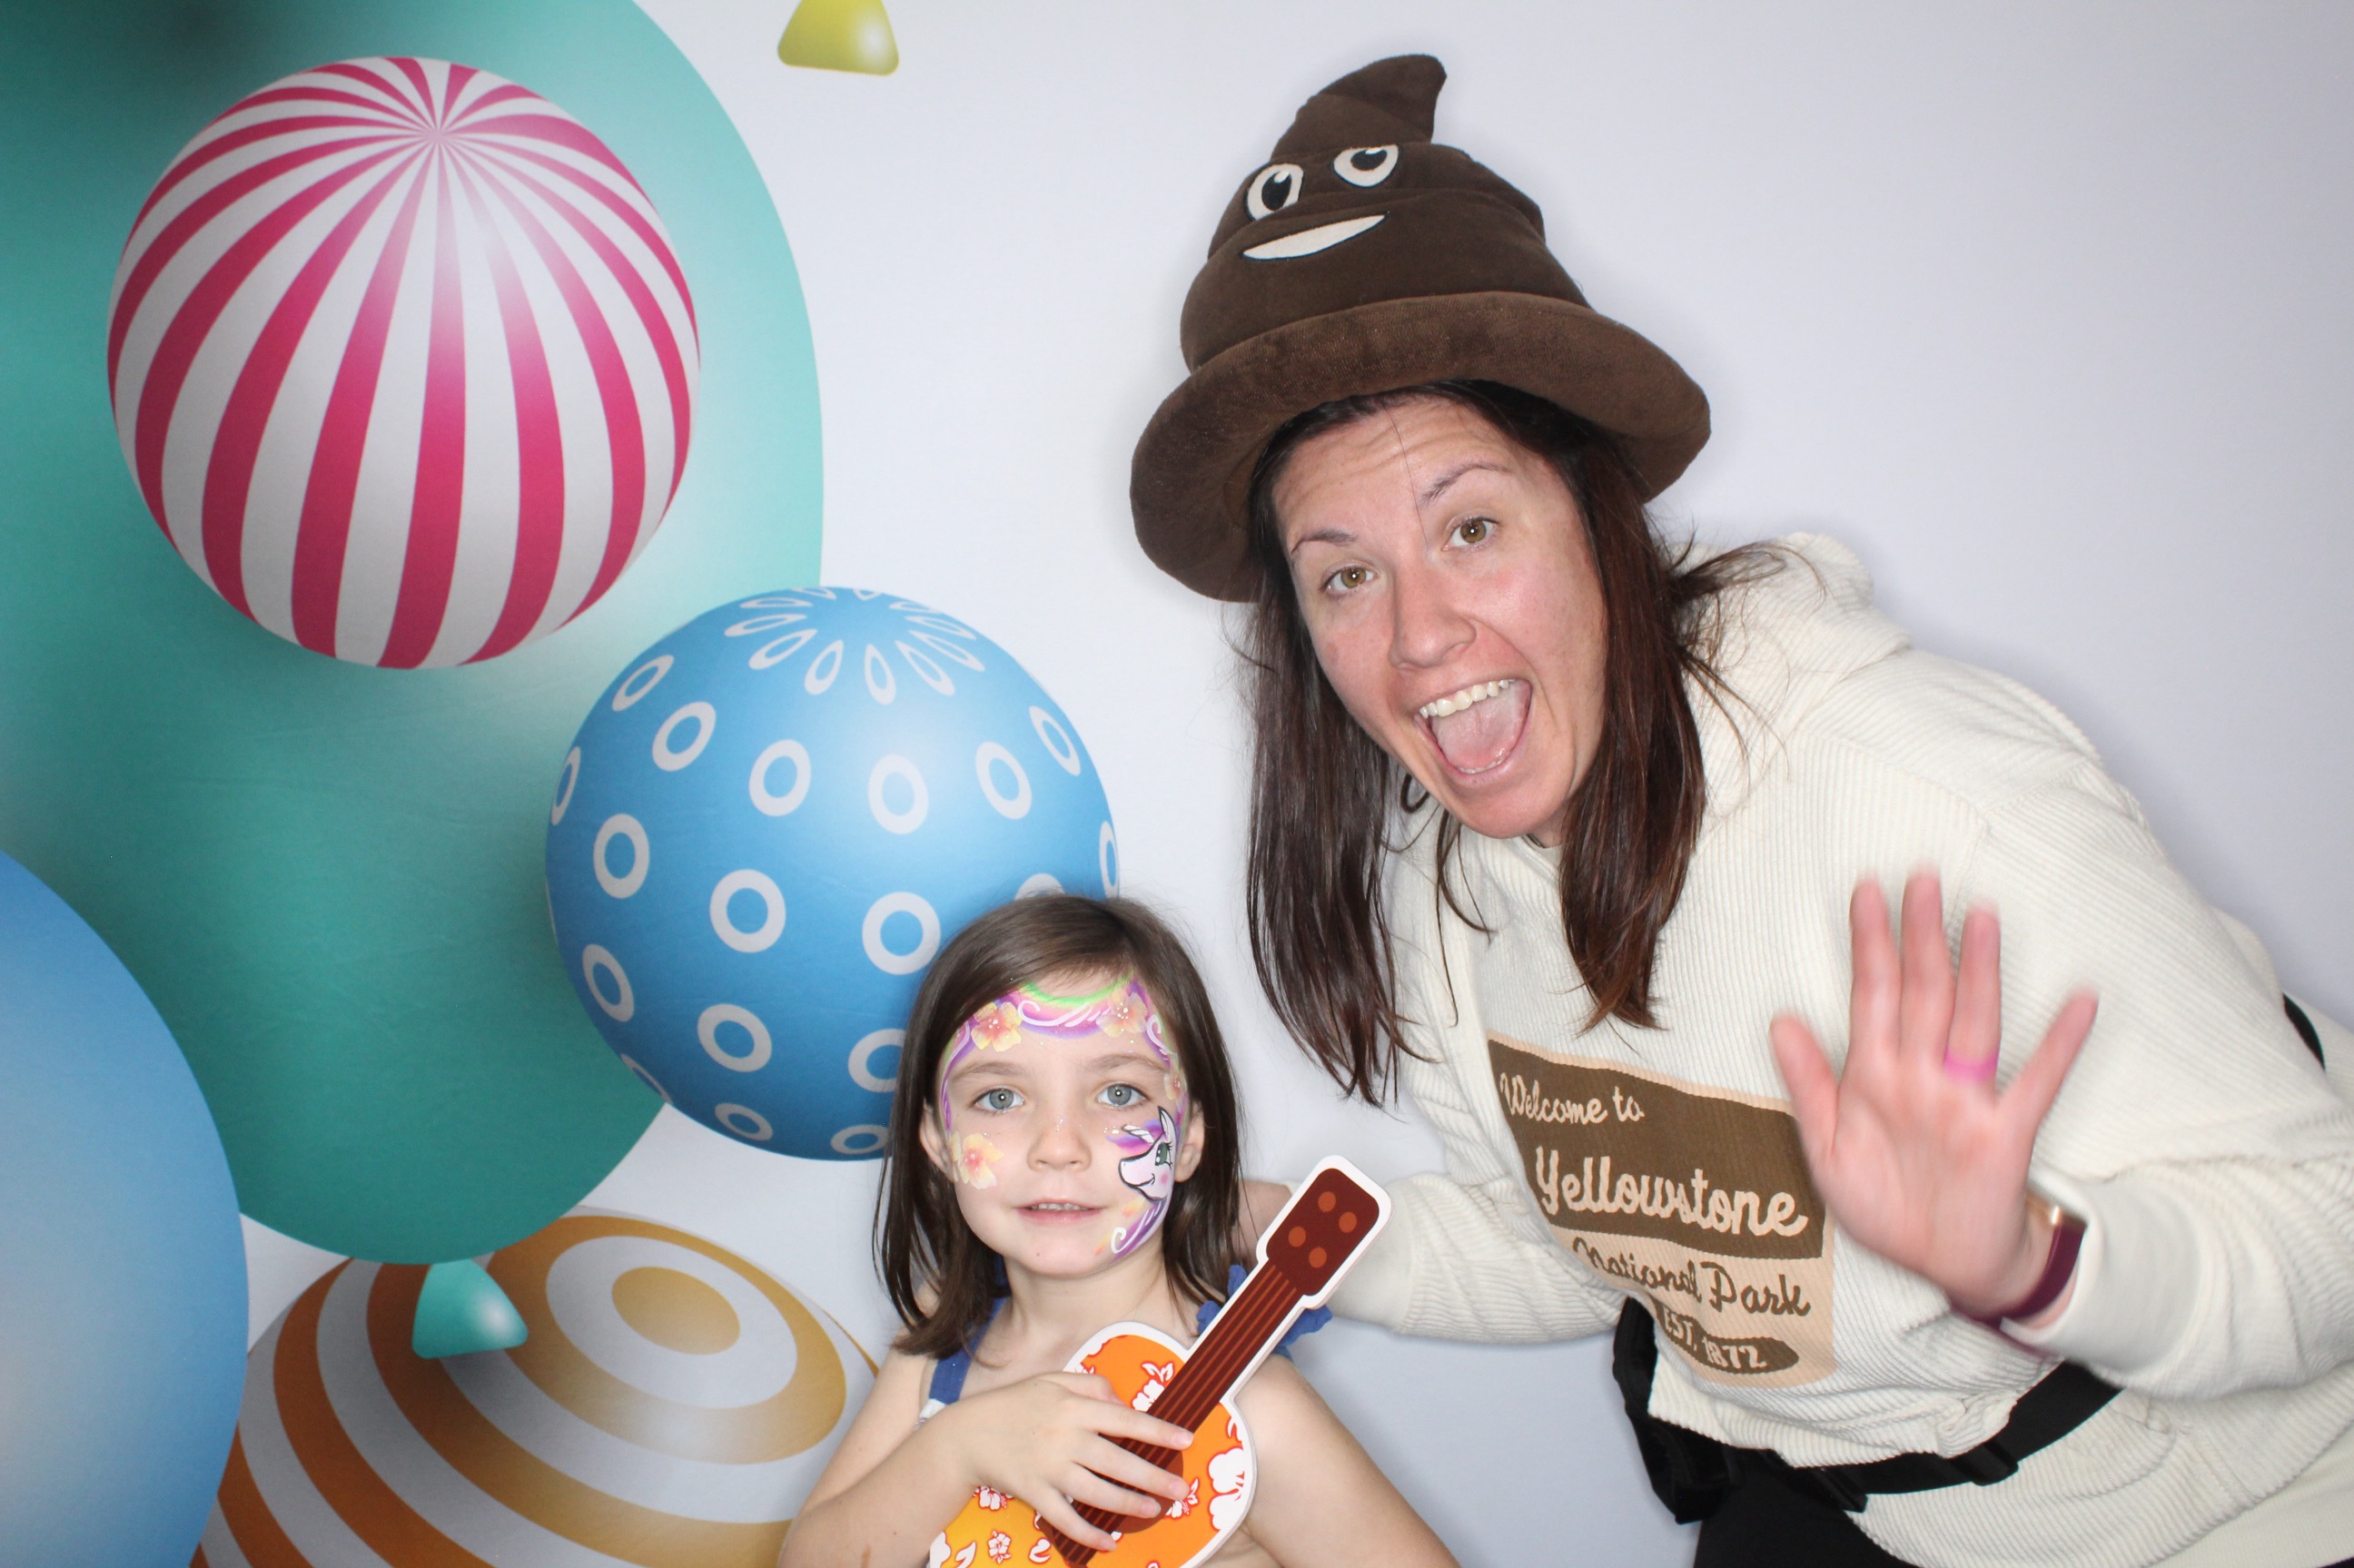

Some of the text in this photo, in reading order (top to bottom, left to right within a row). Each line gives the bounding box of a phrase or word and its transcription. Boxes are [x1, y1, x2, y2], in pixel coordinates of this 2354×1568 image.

[1499, 1072, 1646, 1125] Welcome to
[1535, 1146, 1808, 1237] Yellowstone
[1572, 1237, 1812, 1317] National Park
[1703, 1337, 1767, 1369] 1872
